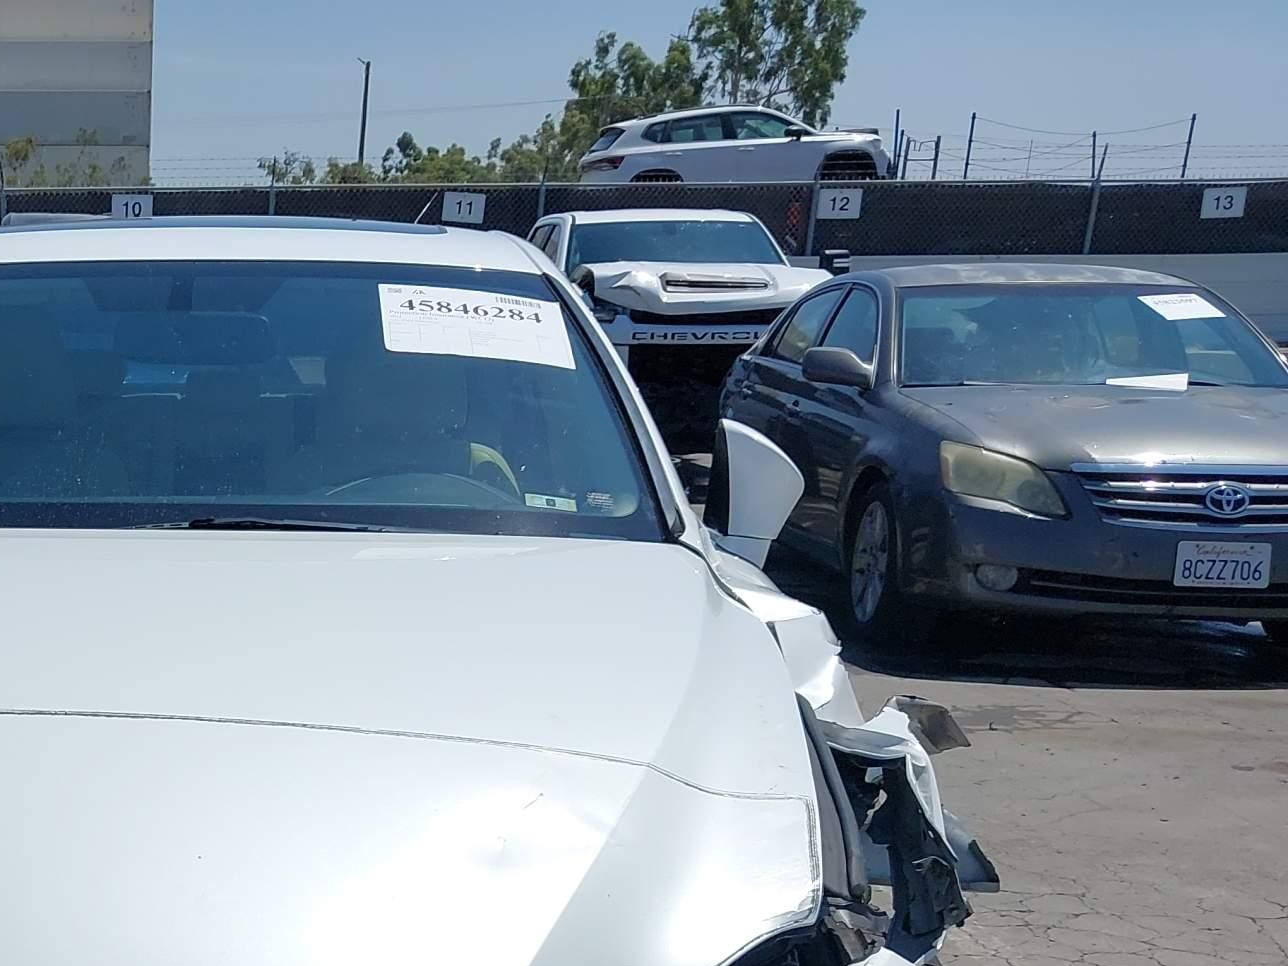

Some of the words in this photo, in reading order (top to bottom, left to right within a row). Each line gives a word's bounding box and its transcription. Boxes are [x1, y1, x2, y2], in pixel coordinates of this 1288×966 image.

[122, 201, 142, 218] 10
[456, 200, 473, 215] 11
[829, 196, 850, 211] 12
[1213, 195, 1234, 210] 13
[399, 299, 543, 323] 45846284
[632, 331, 761, 340] CHEVROL
[1196, 544, 1252, 558] California
[1182, 559, 1264, 581] 8CZZ706
